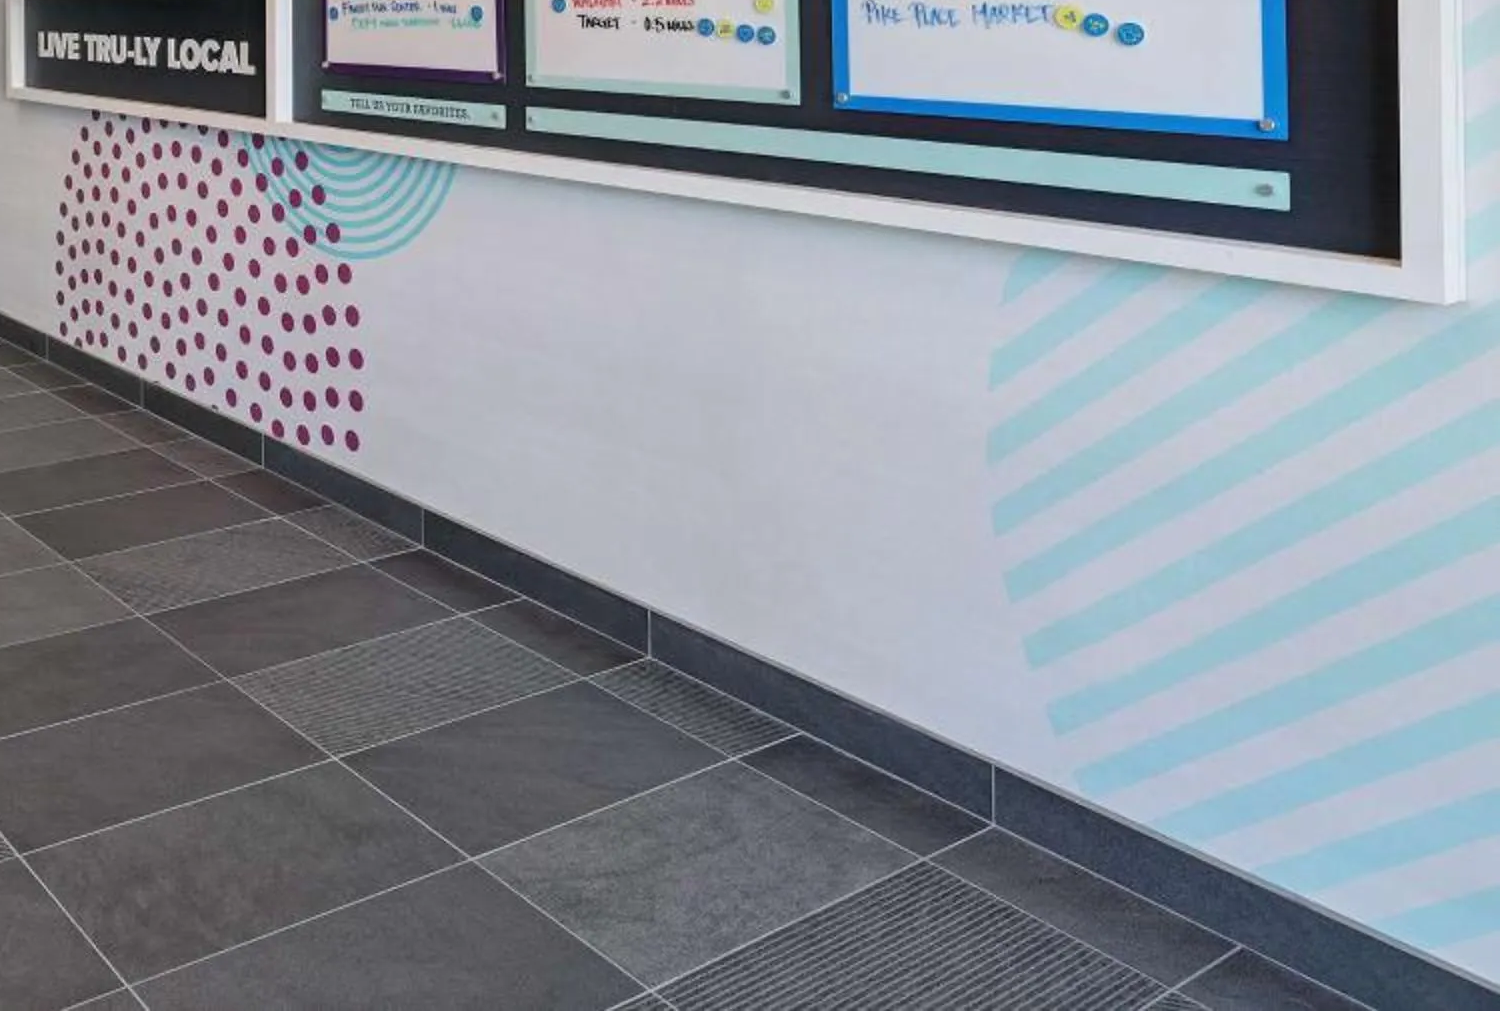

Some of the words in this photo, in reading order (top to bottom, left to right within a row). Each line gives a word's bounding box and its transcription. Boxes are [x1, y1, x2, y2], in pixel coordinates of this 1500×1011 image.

[37, 31, 80, 60] LIVE
[84, 33, 162, 67] TRU-LY
[167, 38, 256, 76] LOCAL
